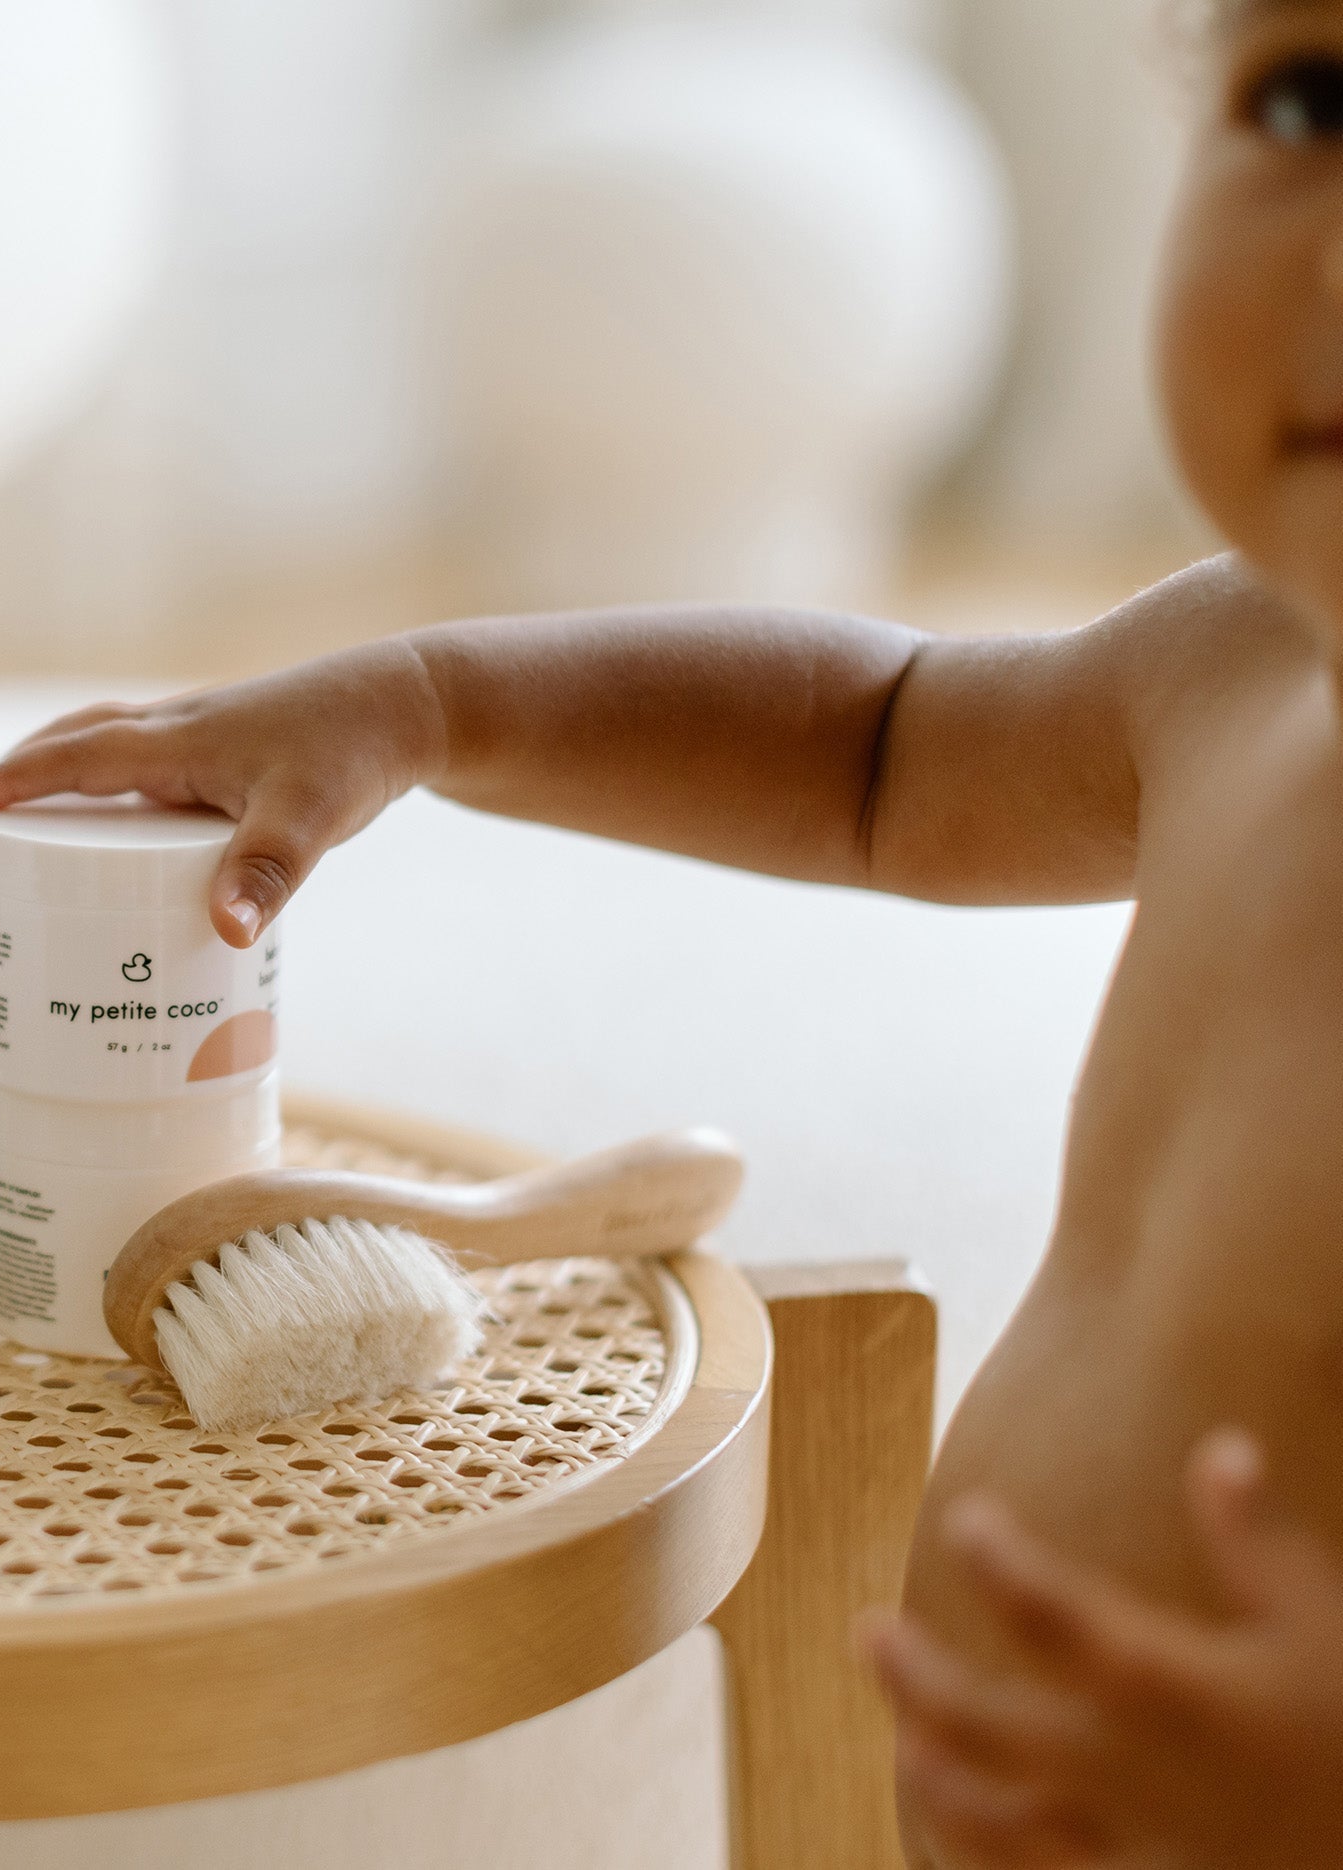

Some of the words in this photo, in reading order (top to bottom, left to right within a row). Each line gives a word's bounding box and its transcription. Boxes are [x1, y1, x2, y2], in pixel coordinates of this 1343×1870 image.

[50, 1000, 81, 1022] my
[91, 1001, 157, 1023] petite
[167, 1001, 219, 1019] coco
[107, 1043, 118, 1051] 57
[121, 1045, 128, 1053] g
[152, 1043, 159, 1051] 2
[161, 1043, 172, 1051] oz
